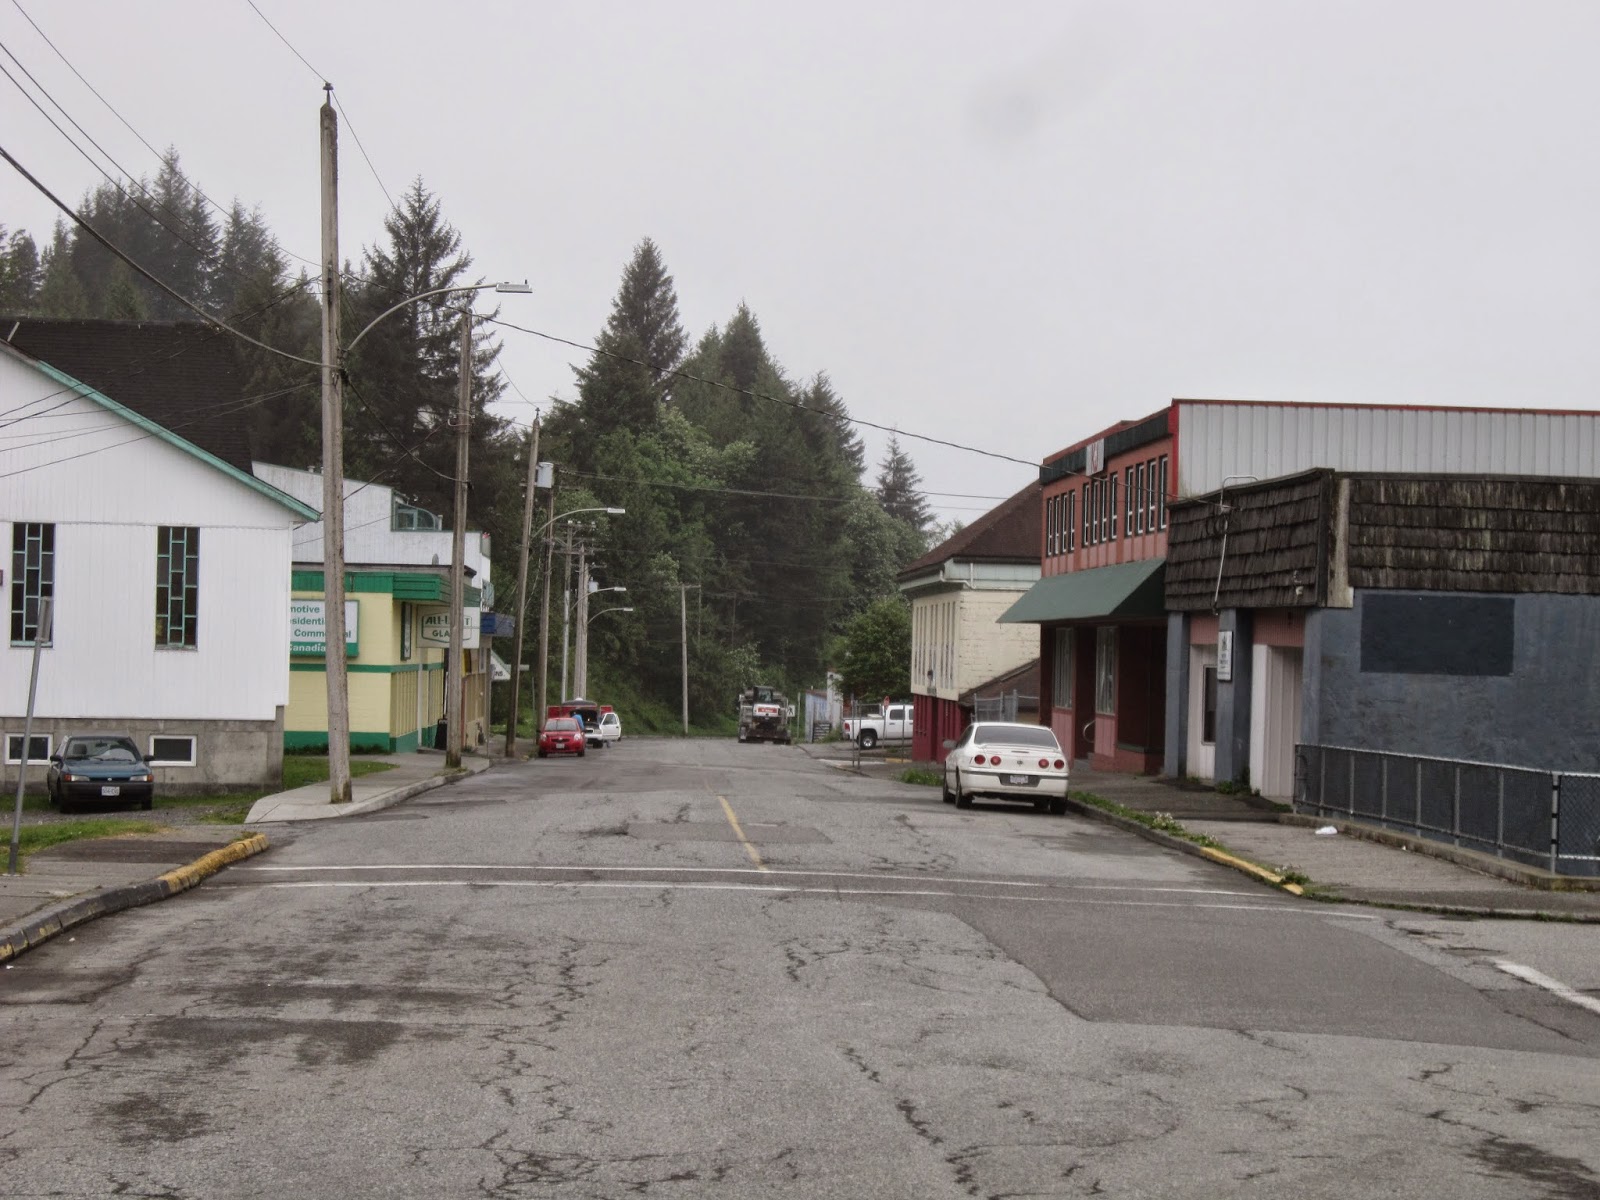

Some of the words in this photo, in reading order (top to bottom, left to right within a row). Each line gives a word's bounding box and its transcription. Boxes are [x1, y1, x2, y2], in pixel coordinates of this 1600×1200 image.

[290, 617, 325, 625] sidenti
[294, 629, 352, 638] Commal
[432, 630, 450, 638] GLA
